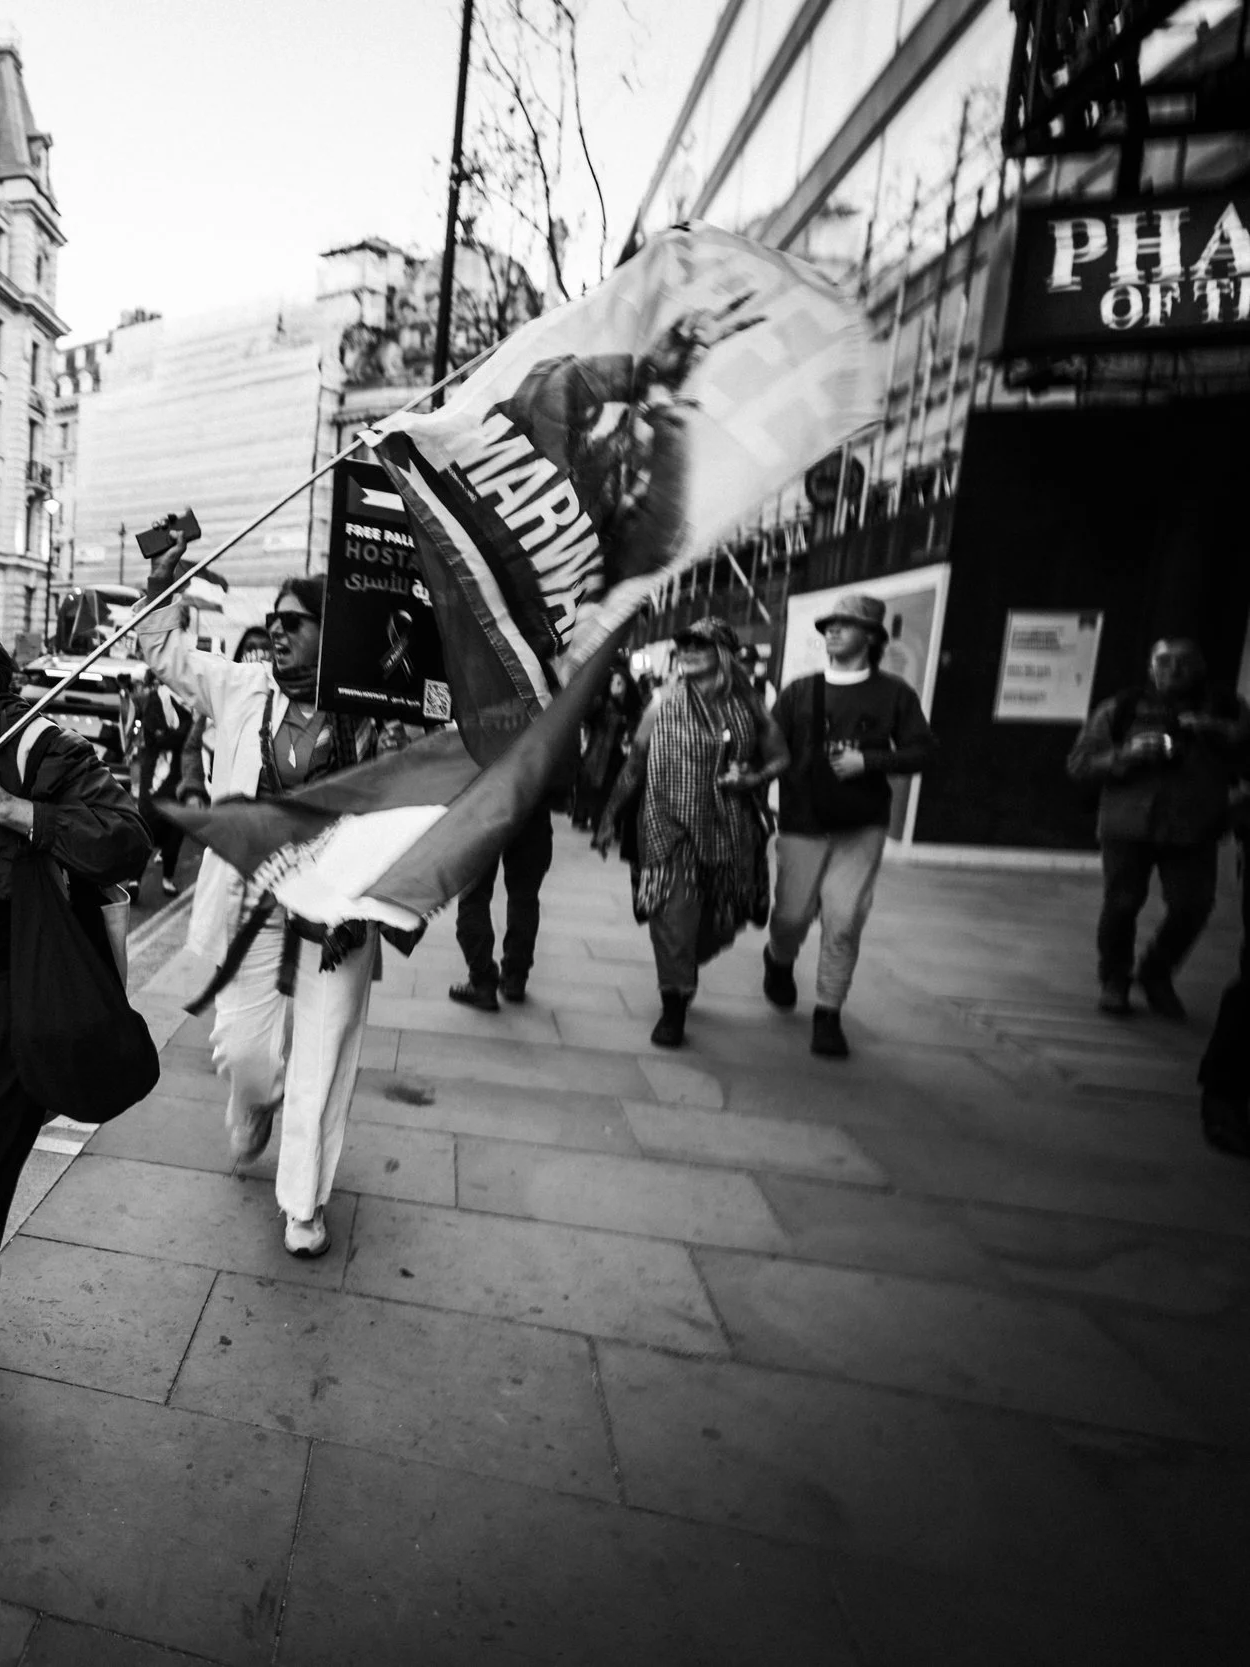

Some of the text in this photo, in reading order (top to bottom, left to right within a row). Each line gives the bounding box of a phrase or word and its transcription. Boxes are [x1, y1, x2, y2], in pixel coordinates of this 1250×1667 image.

[1100, 284, 1181, 330] OF
[345, 522, 382, 541] FREE
[442, 411, 606, 647] MARWA
